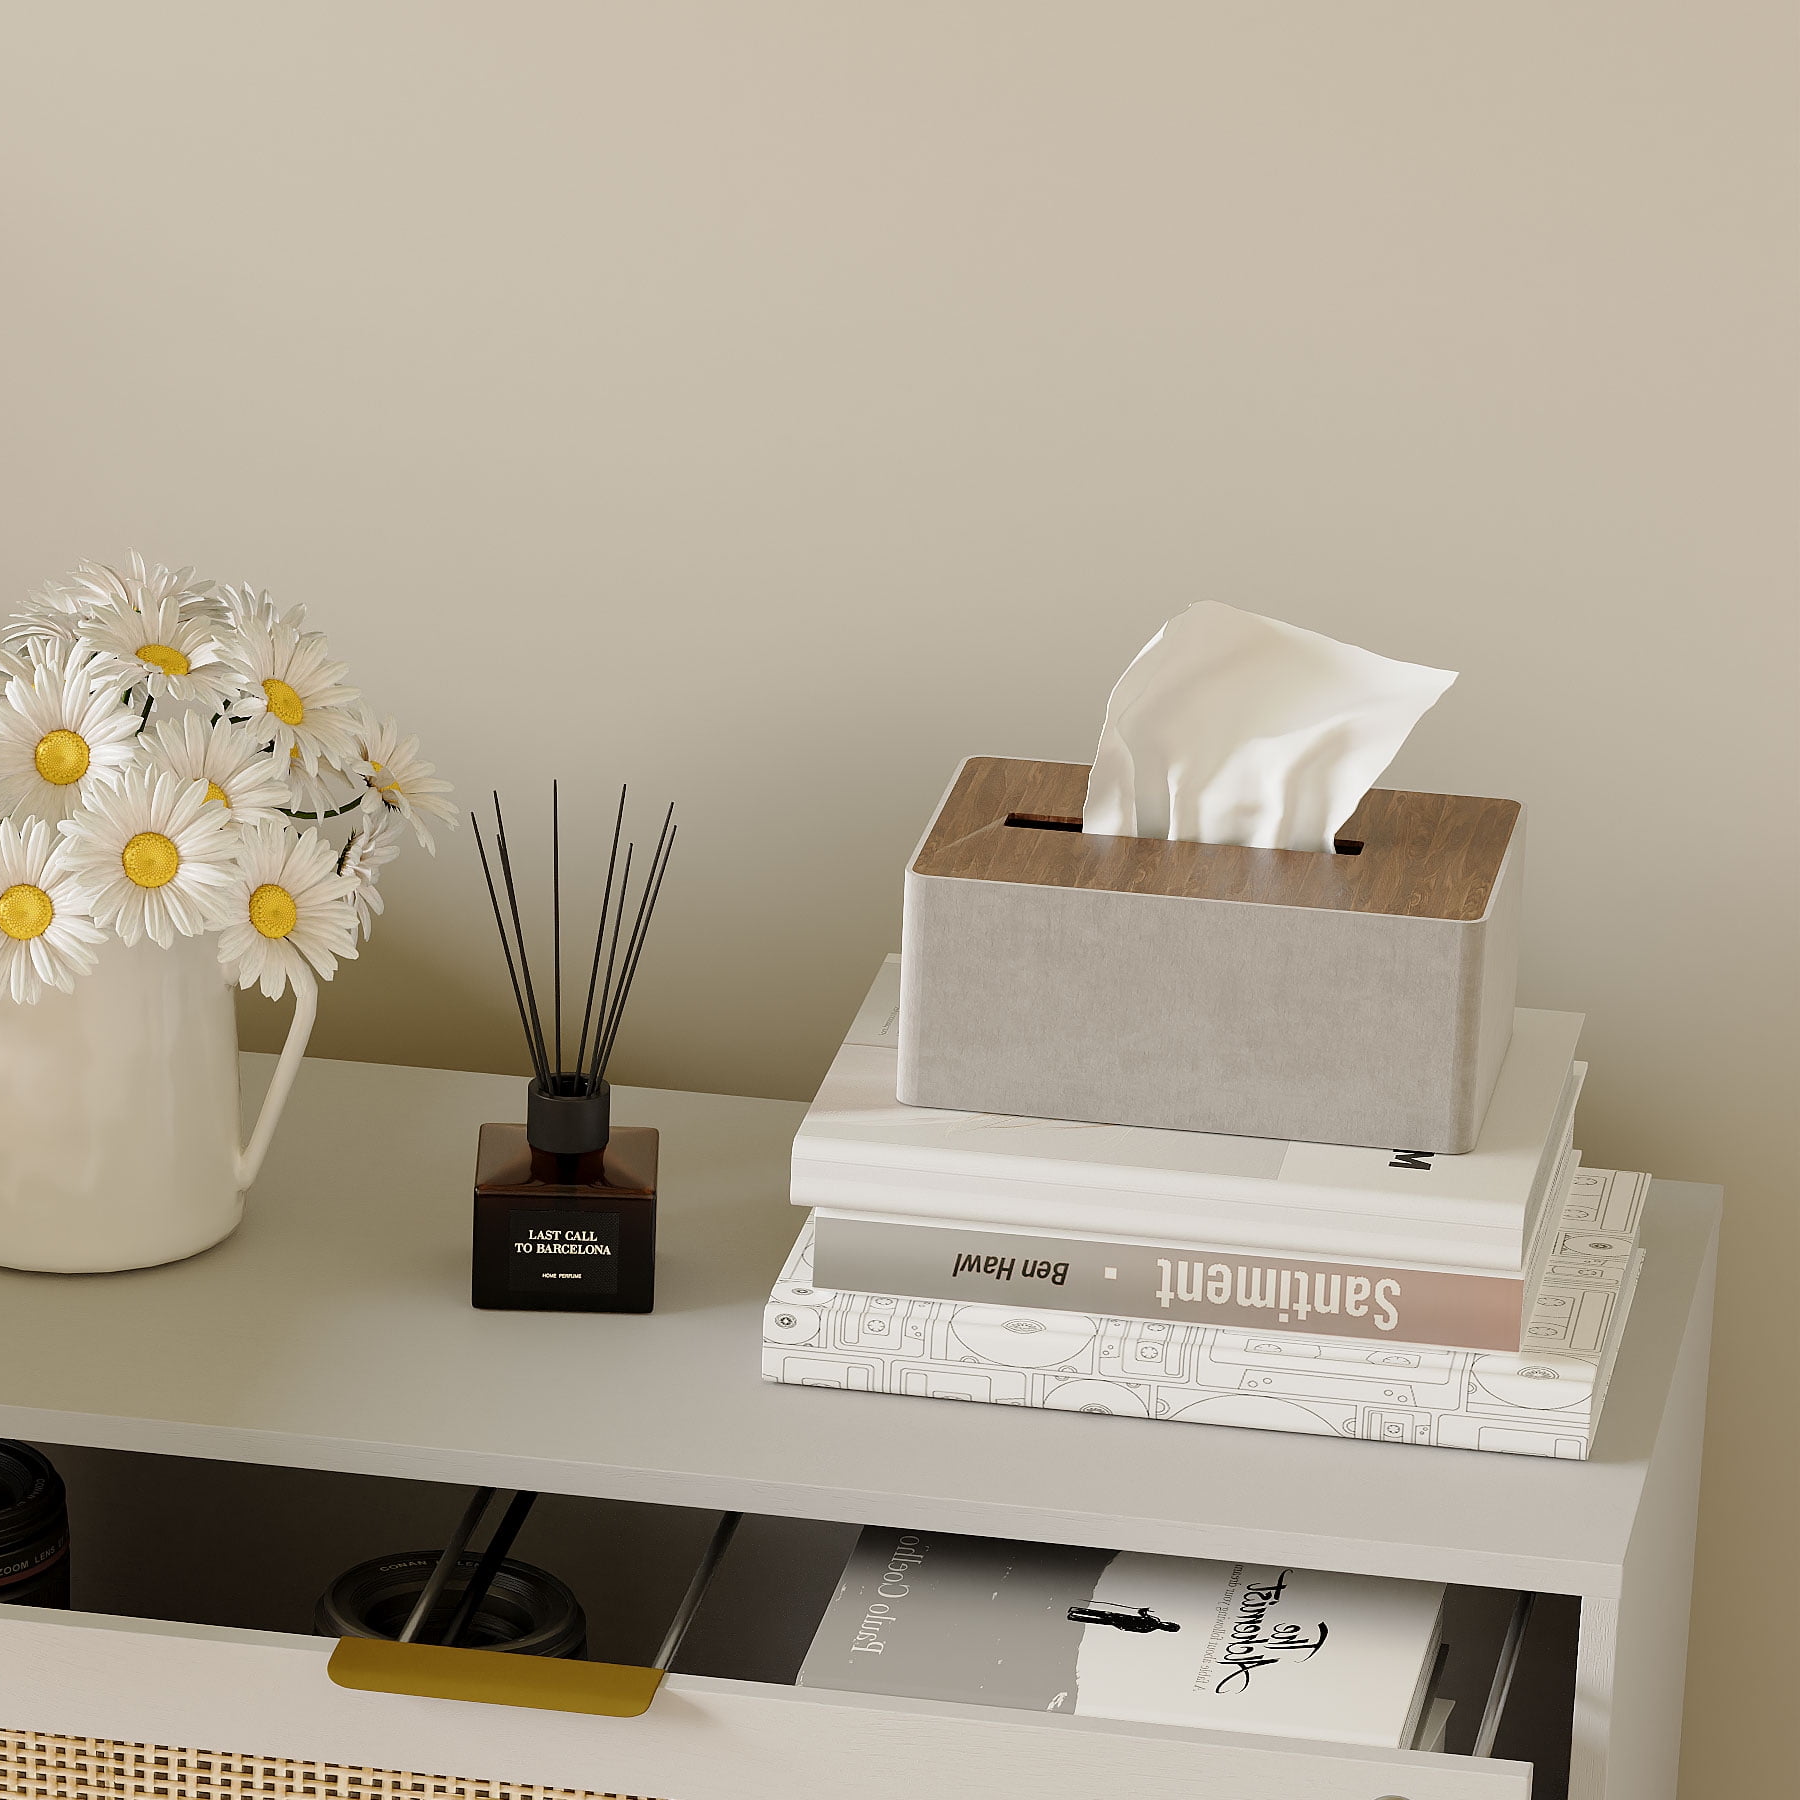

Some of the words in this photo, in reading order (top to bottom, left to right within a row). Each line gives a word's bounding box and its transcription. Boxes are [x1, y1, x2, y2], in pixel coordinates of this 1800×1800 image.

[528, 1229, 561, 1241] LAST
[565, 1230, 598, 1242] CALL
[514, 1242, 532, 1254] TO
[536, 1243, 611, 1256] BARCELONA
[952, 1252, 1016, 1281] Hawl
[1021, 1258, 1070, 1286] Ben
[1156, 1258, 1402, 1332] Santiment
[34, 1545, 56, 1563] LENS
[379, 1560, 427, 1572] CONAN
